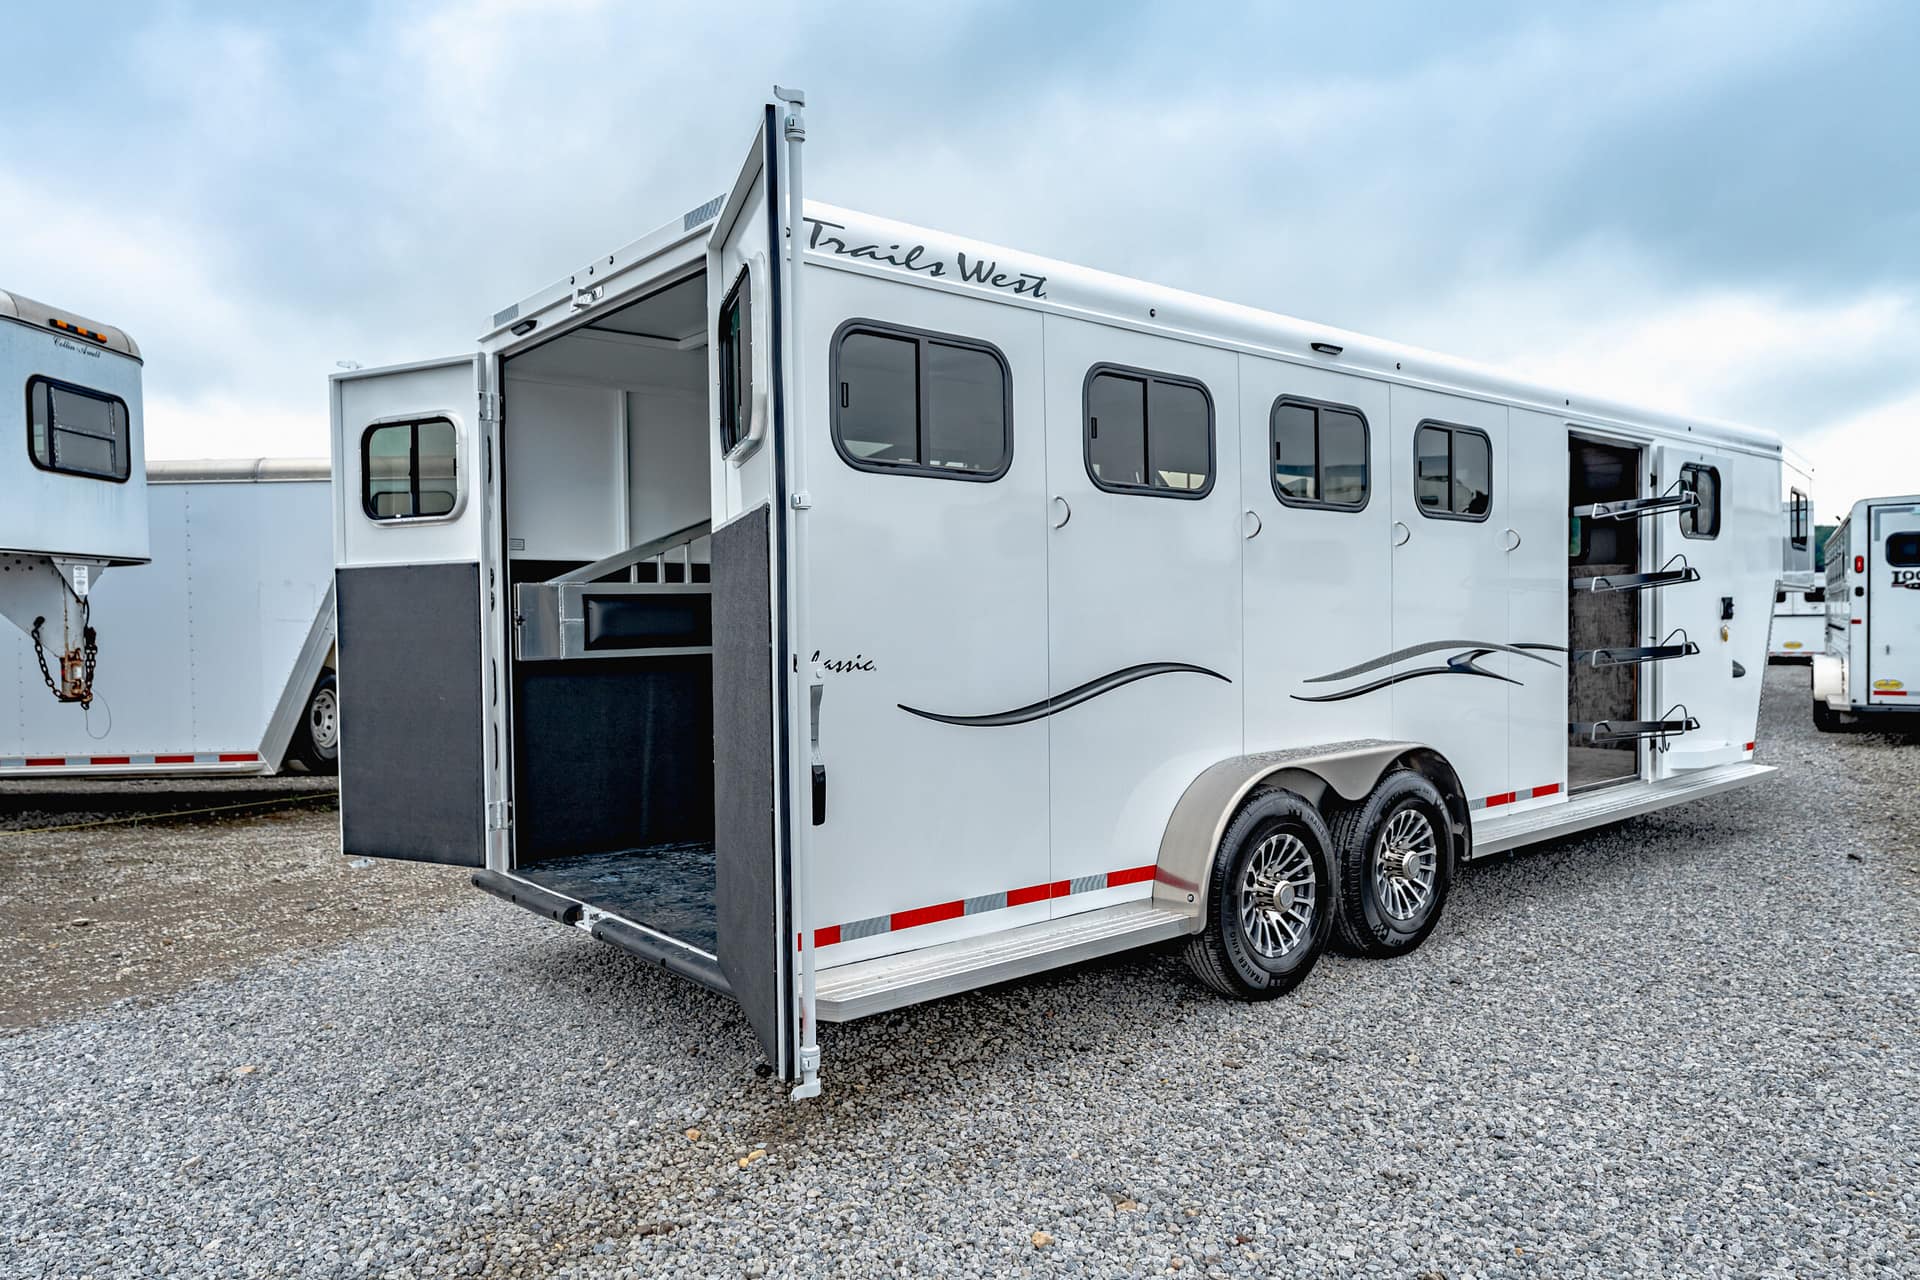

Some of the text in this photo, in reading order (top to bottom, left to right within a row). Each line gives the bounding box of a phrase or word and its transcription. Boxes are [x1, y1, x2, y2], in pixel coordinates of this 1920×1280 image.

[802, 216, 1047, 298] Trails West
[1238, 956, 1264, 985] TRAILER
